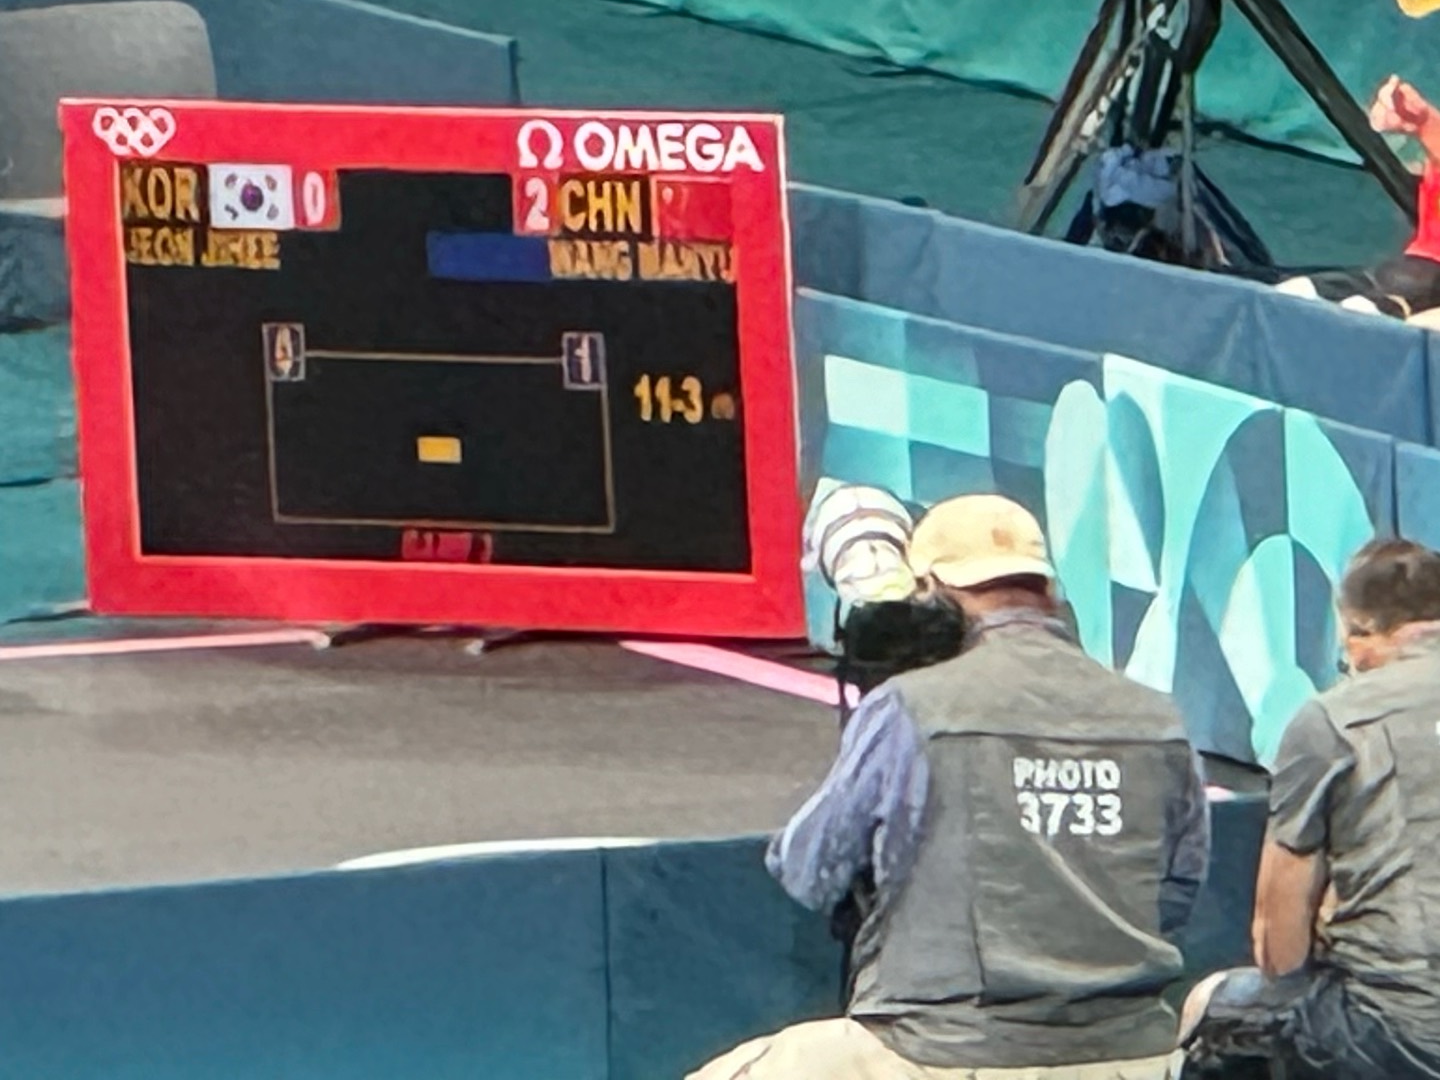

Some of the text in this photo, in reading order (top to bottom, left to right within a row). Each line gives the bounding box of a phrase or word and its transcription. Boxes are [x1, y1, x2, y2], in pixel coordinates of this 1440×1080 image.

[573, 120, 765, 173] OMEGA
[122, 166, 327, 226] KOR 0
[525, 176, 642, 234] 2 CHN
[1013, 756, 1121, 791] PHOTO
[1016, 791, 1124, 841] 3733
